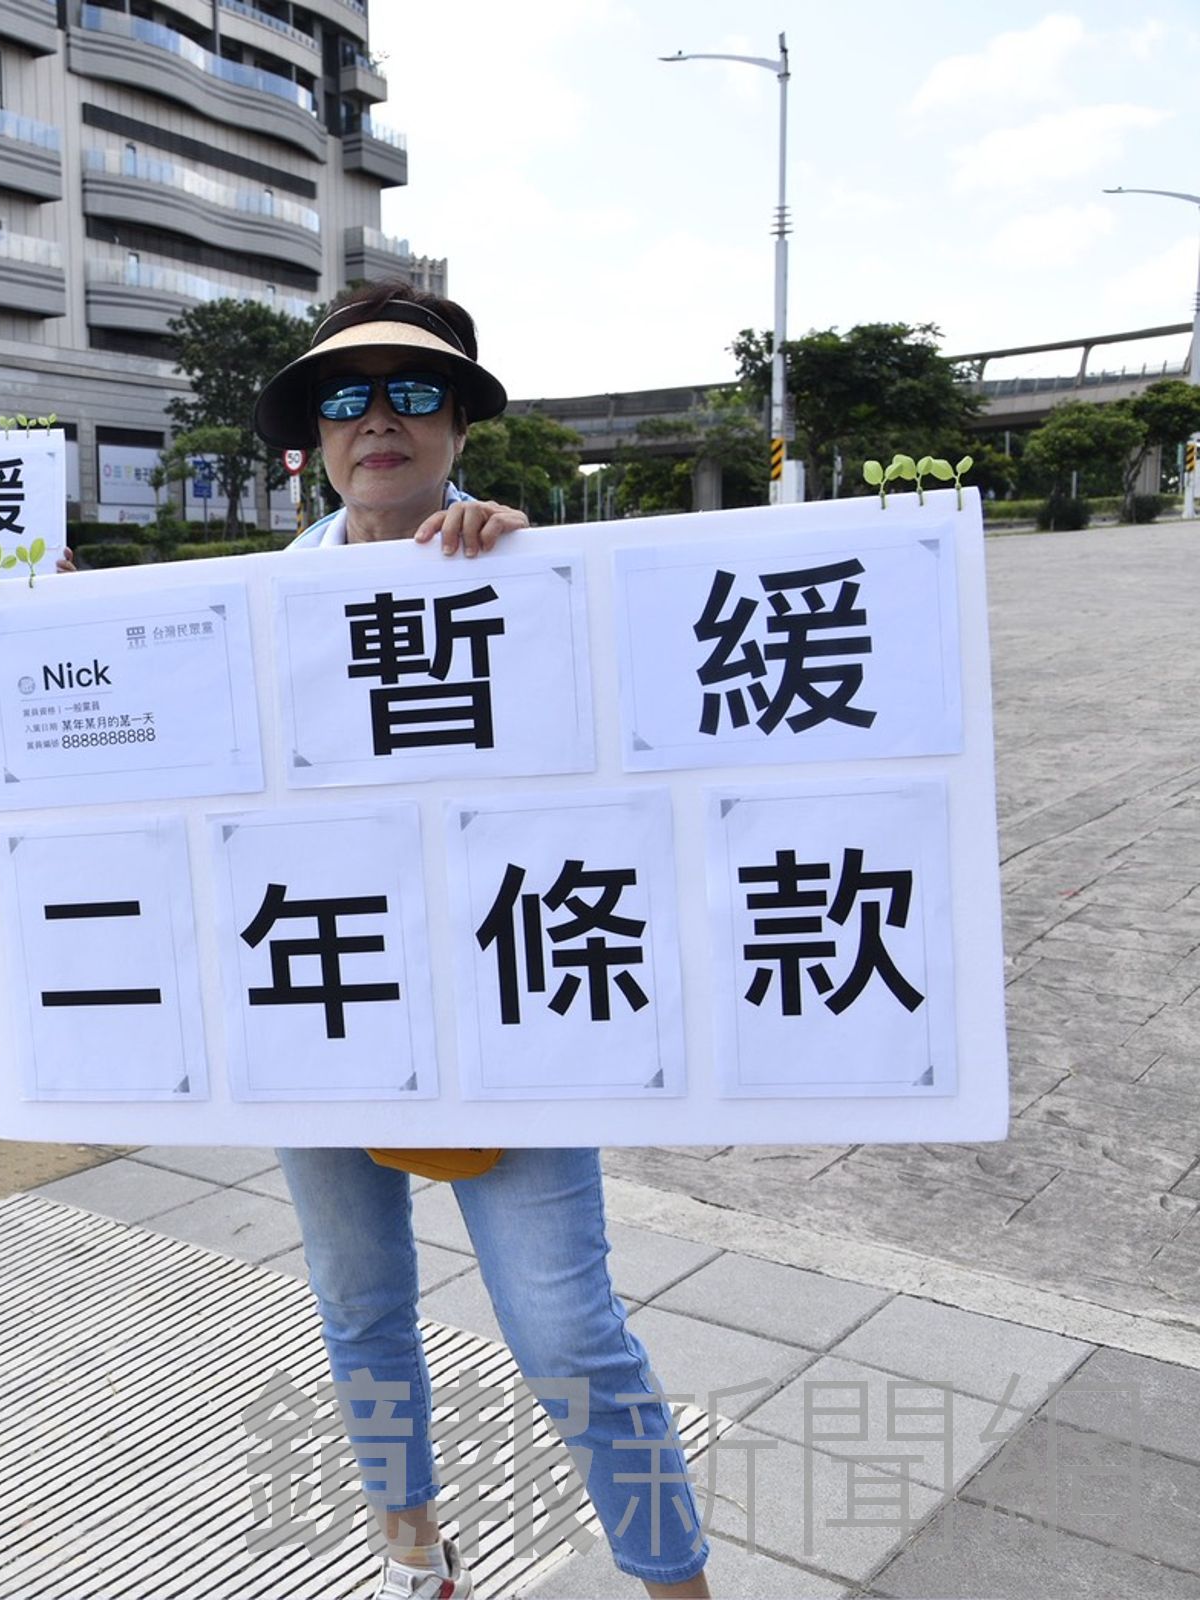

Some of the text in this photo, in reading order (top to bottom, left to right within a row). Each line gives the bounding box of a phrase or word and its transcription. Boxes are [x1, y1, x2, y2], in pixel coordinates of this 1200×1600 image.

[288, 452, 300, 465] 50
[344, 558, 877, 756] 暫緩
[43, 659, 112, 691] Nick
[62, 712, 155, 732] 某年某月的某一天
[62, 727, 156, 749] 8888888888
[41, 847, 925, 1039] 二年條款
